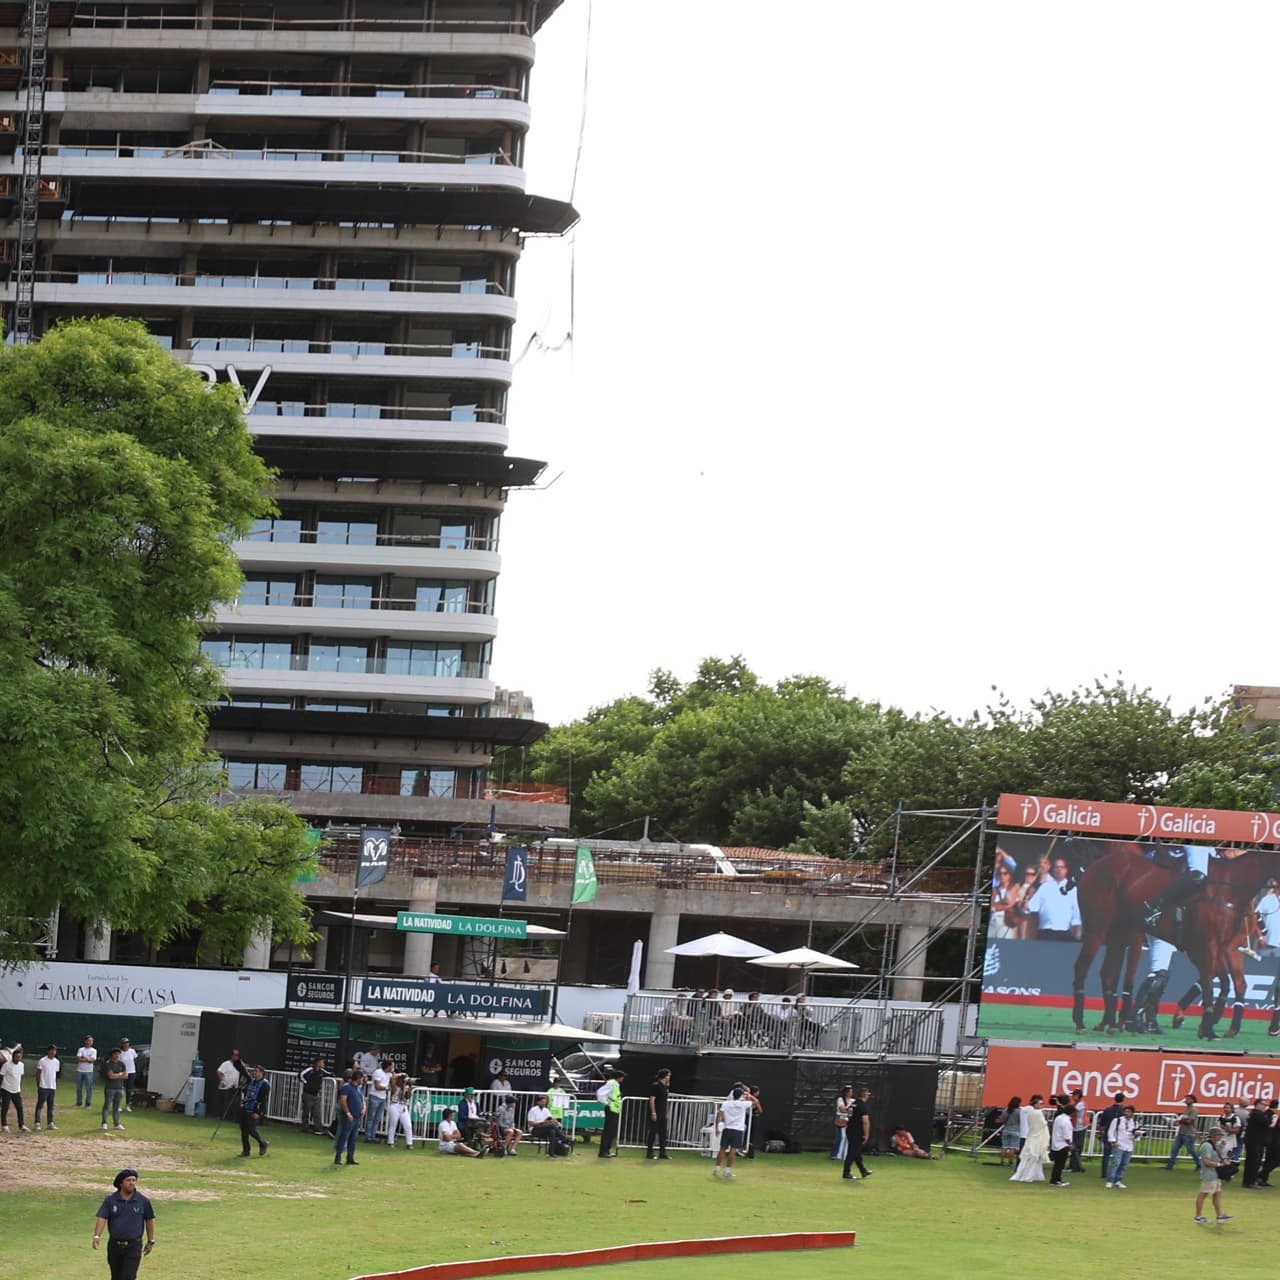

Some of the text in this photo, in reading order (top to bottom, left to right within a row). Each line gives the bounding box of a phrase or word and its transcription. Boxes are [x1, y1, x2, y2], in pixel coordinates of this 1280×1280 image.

[1043, 803, 1101, 827] Galicia
[1160, 813, 1216, 835] Galicia
[403, 916, 452, 930] LA NATIVIDAD
[458, 922, 522, 935] LA DOLFINA
[308, 982, 335, 992] SANCOR
[368, 985, 435, 1003] LA NATIVIDAD
[307, 990, 335, 1000] SEGUROS
[447, 992, 533, 1009] LA DOLFINA
[505, 1058, 542, 1068] SANCOR
[504, 1067, 542, 1077] SEGUROS
[1046, 1060, 1140, 1099] Tenés
[1199, 1072, 1274, 1100] Galicia
